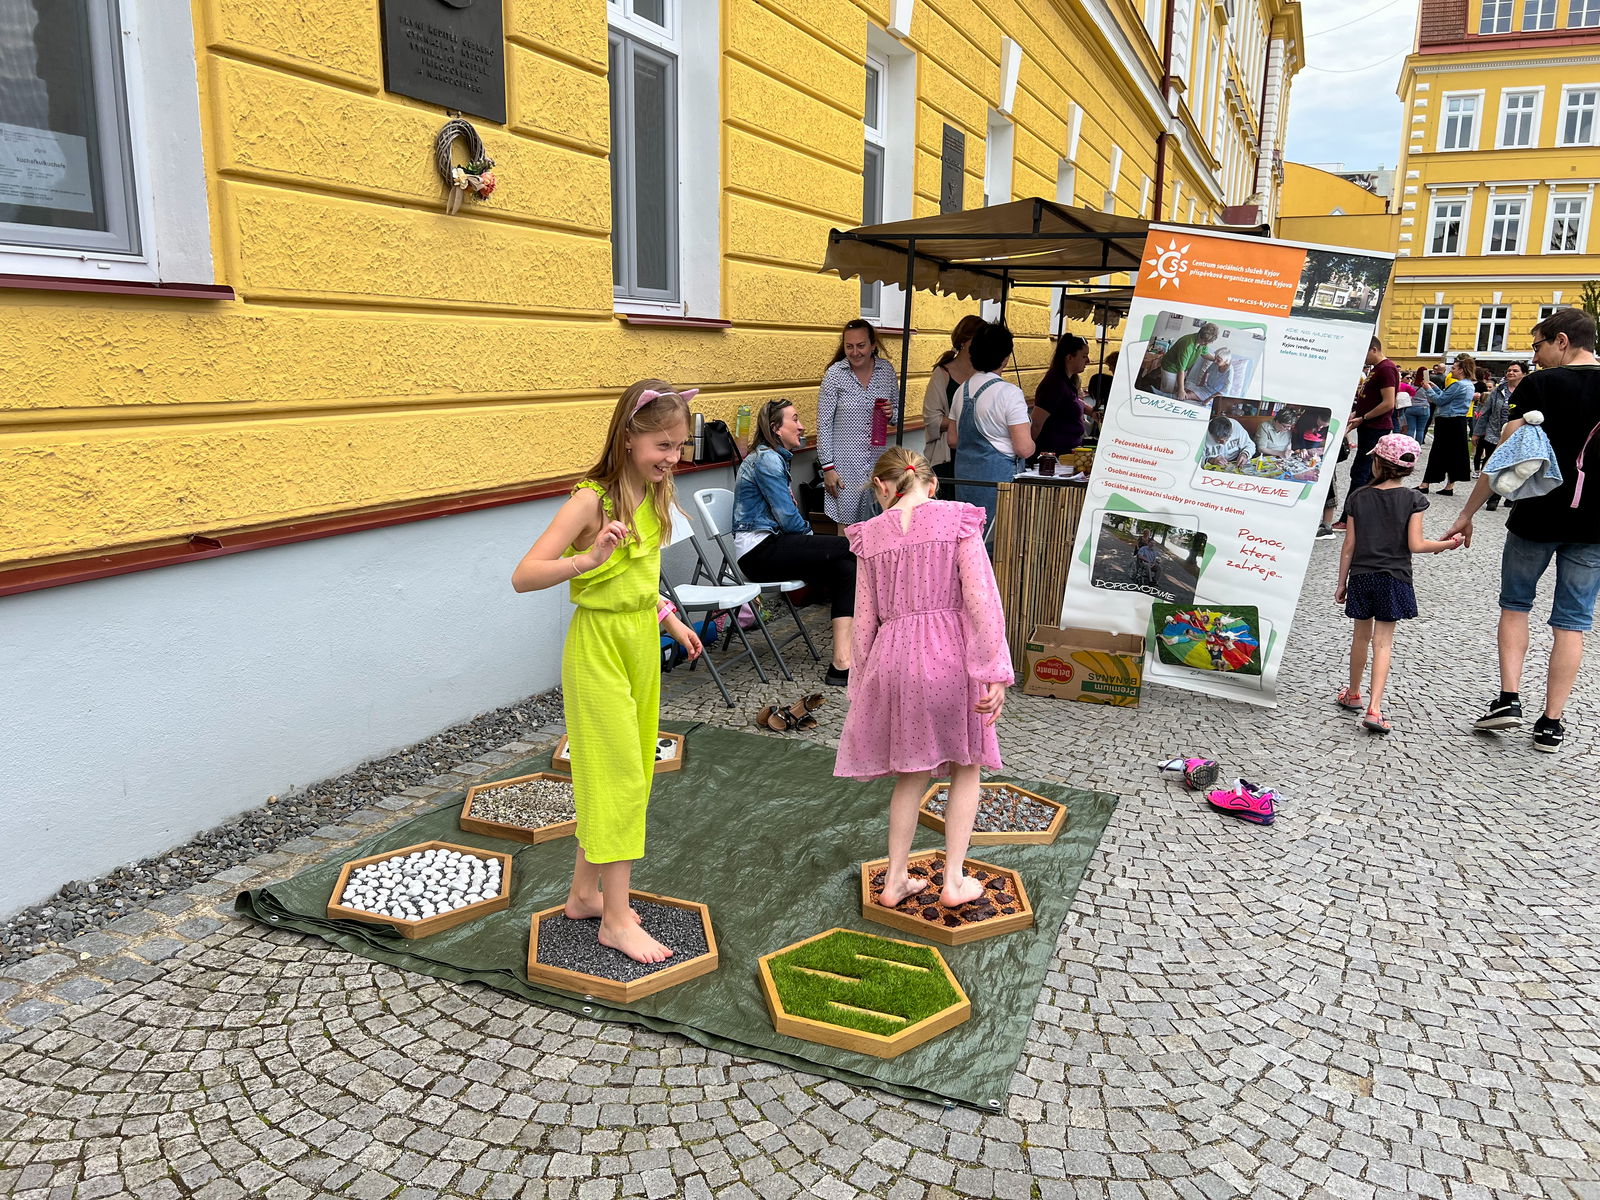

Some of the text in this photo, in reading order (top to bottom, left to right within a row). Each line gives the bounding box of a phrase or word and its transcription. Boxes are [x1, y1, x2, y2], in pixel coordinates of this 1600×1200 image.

[1192, 259, 1280, 278] Centrum sociálních služeb Kyjov
[1189, 269, 1293, 289] příspěvková organizace města Kyjova
[1227, 296, 1288, 310] www.css-kyjov.cz
[1135, 394, 1199, 419] POMŮŽEME
[1114, 438, 1174, 455] Pečovatelská služba
[1111, 452, 1157, 466] Denní stacionář
[1108, 466, 1157, 481] Osobní asistence
[1201, 476, 1290, 498] DOHLEDNEME
[1129, 486, 1162, 498] aktivizační
[1163, 494, 1183, 503] služby
[1197, 502, 1219, 511] rodiny
[1224, 506, 1245, 515] dětmi
[1238, 529, 1286, 551] Pomoc,
[1240, 544, 1276, 562] která
[1037, 665, 1071, 677] Del Monte
[1088, 672, 1137, 686] BANANAS
[1094, 683, 1137, 696] Premium
